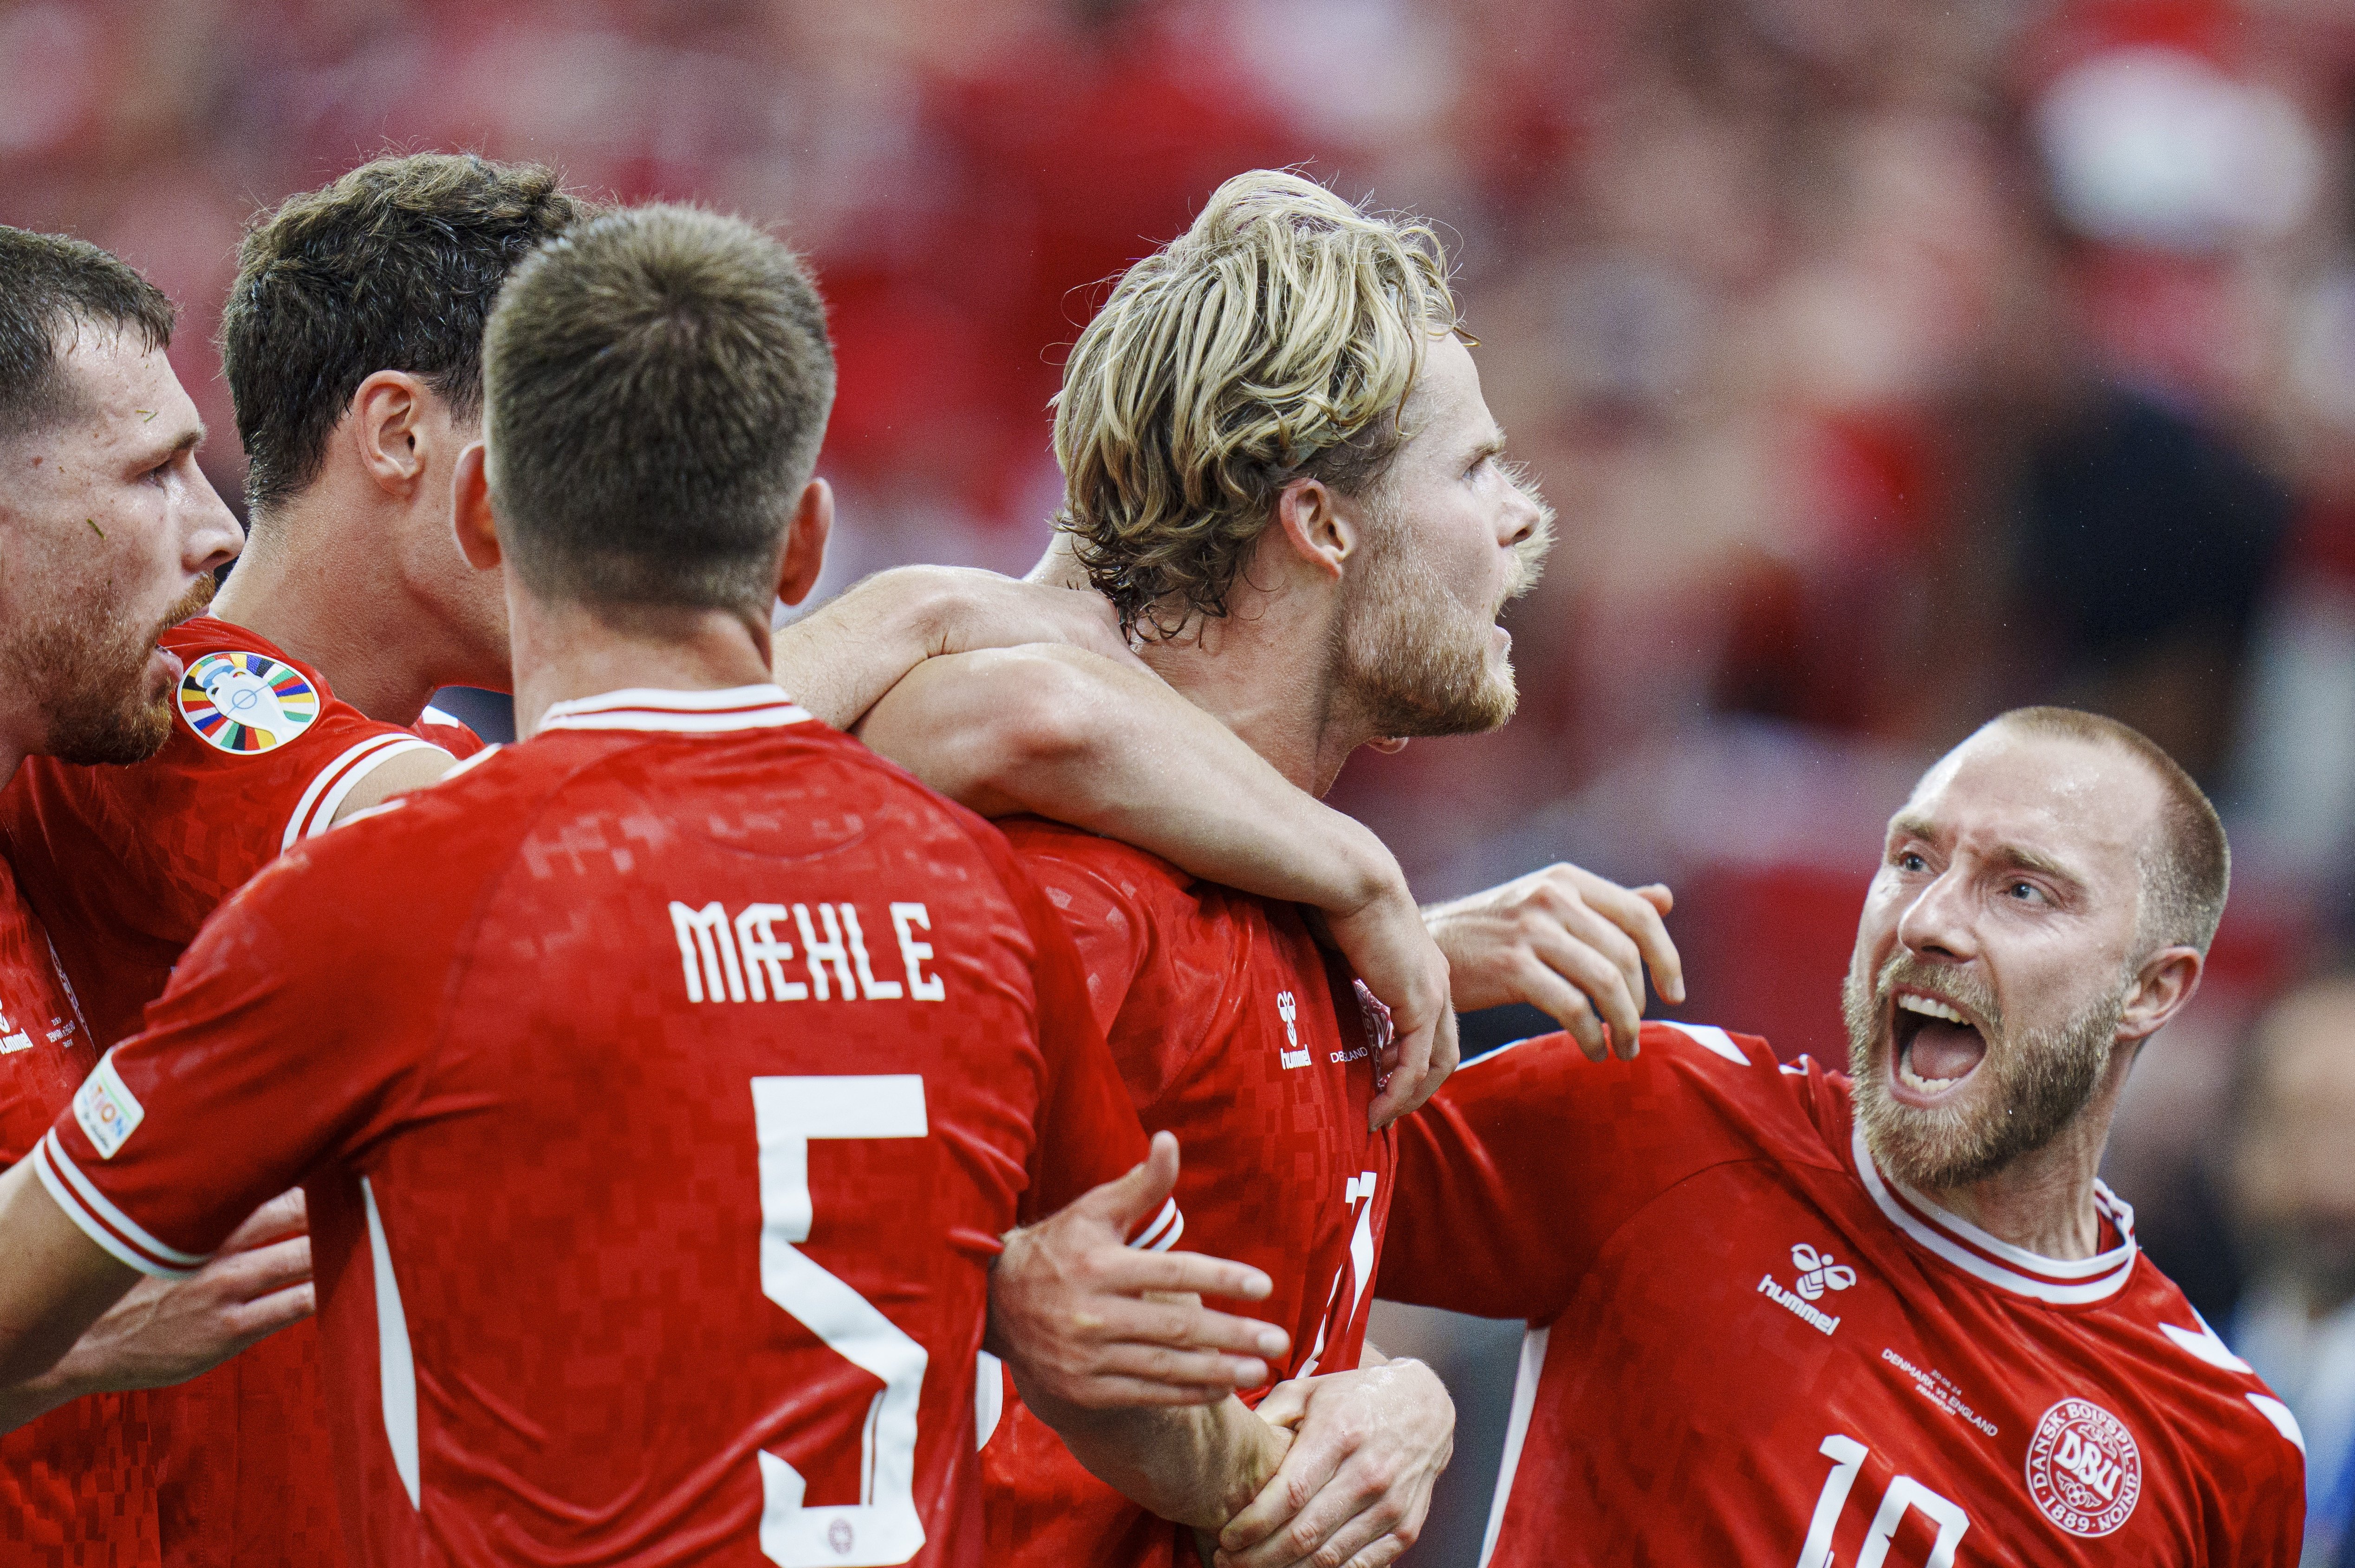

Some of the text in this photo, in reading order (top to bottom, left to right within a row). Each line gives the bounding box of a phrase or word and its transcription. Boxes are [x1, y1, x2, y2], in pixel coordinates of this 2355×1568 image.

[668, 901, 945, 1003] MÆHLE
[0, 1028, 33, 1055] ummel
[1280, 1043, 1312, 1070] hummel
[750, 1074, 928, 1568] 5
[1757, 1273, 1841, 1336] hummel
[1882, 1348, 1998, 1437] DENMARK vs ENGLAND
[2031, 1411, 2065, 1489] DANSK
[2097, 1472, 2137, 1531] UNION
[2054, 1430, 2122, 1501] DBU
[2043, 1496, 2090, 1532] 1889
